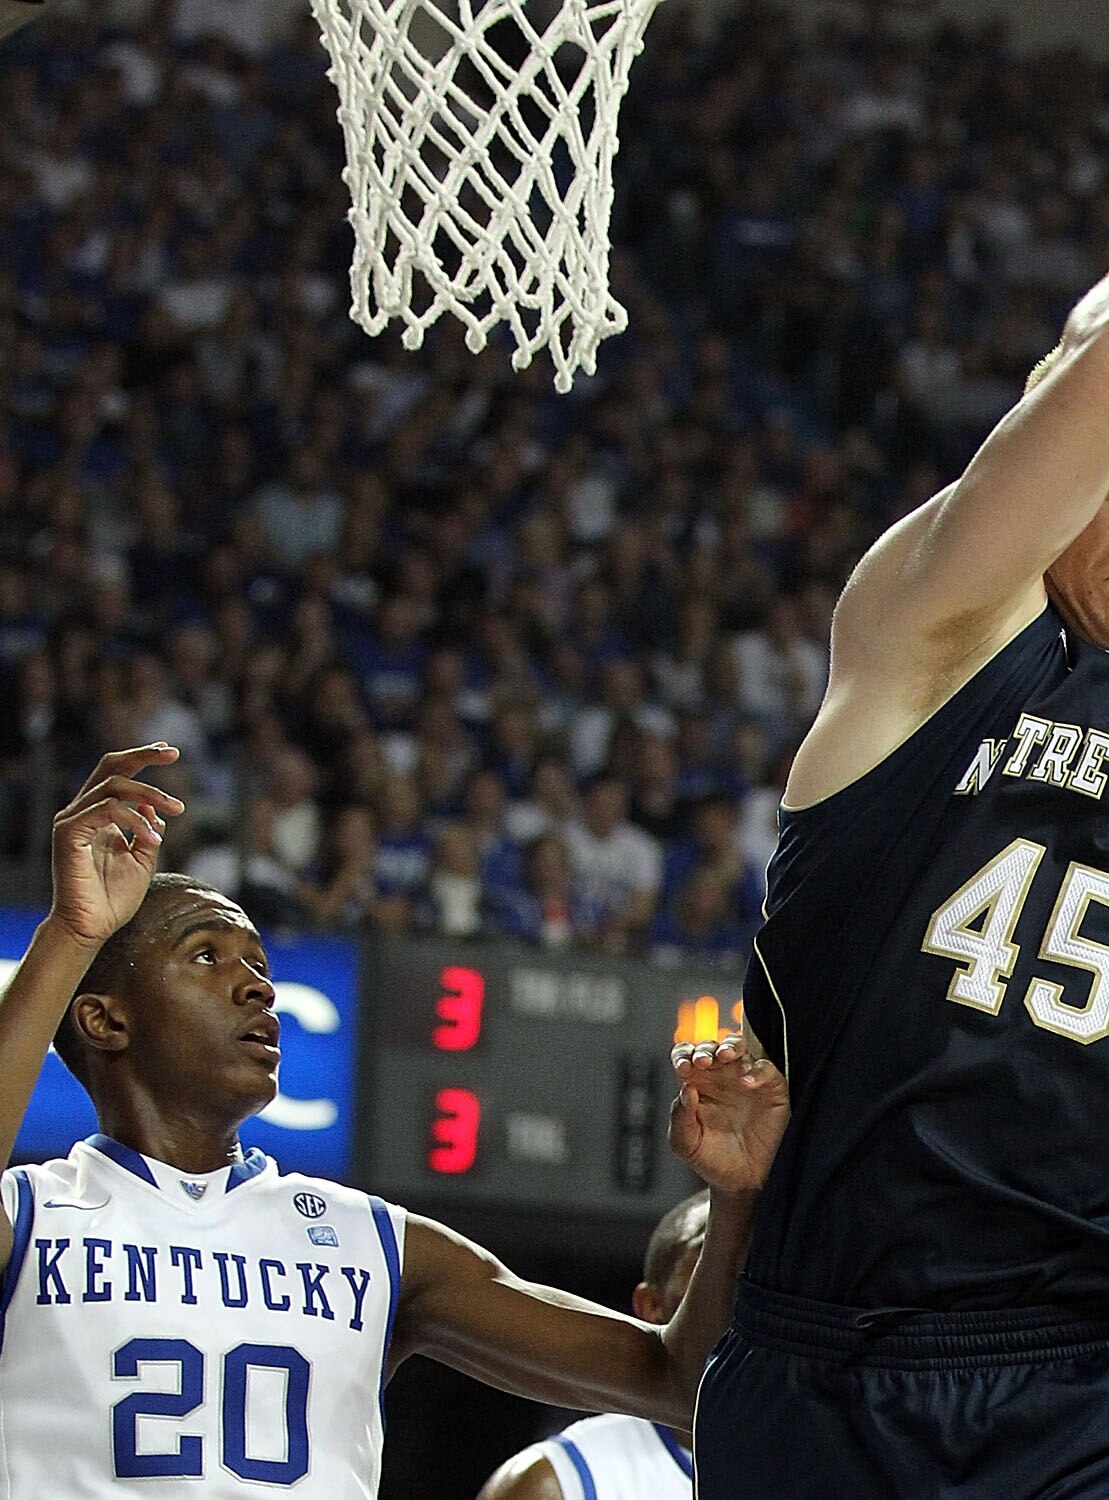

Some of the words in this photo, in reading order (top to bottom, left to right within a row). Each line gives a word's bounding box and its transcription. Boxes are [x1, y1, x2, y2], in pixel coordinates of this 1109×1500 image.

[432, 966, 486, 1052] 3
[428, 1087, 482, 1175] 3
[294, 1193, 327, 1217] SEC
[35, 1237, 373, 1333] KENTUCKY
[110, 1336, 311, 1489] 20
